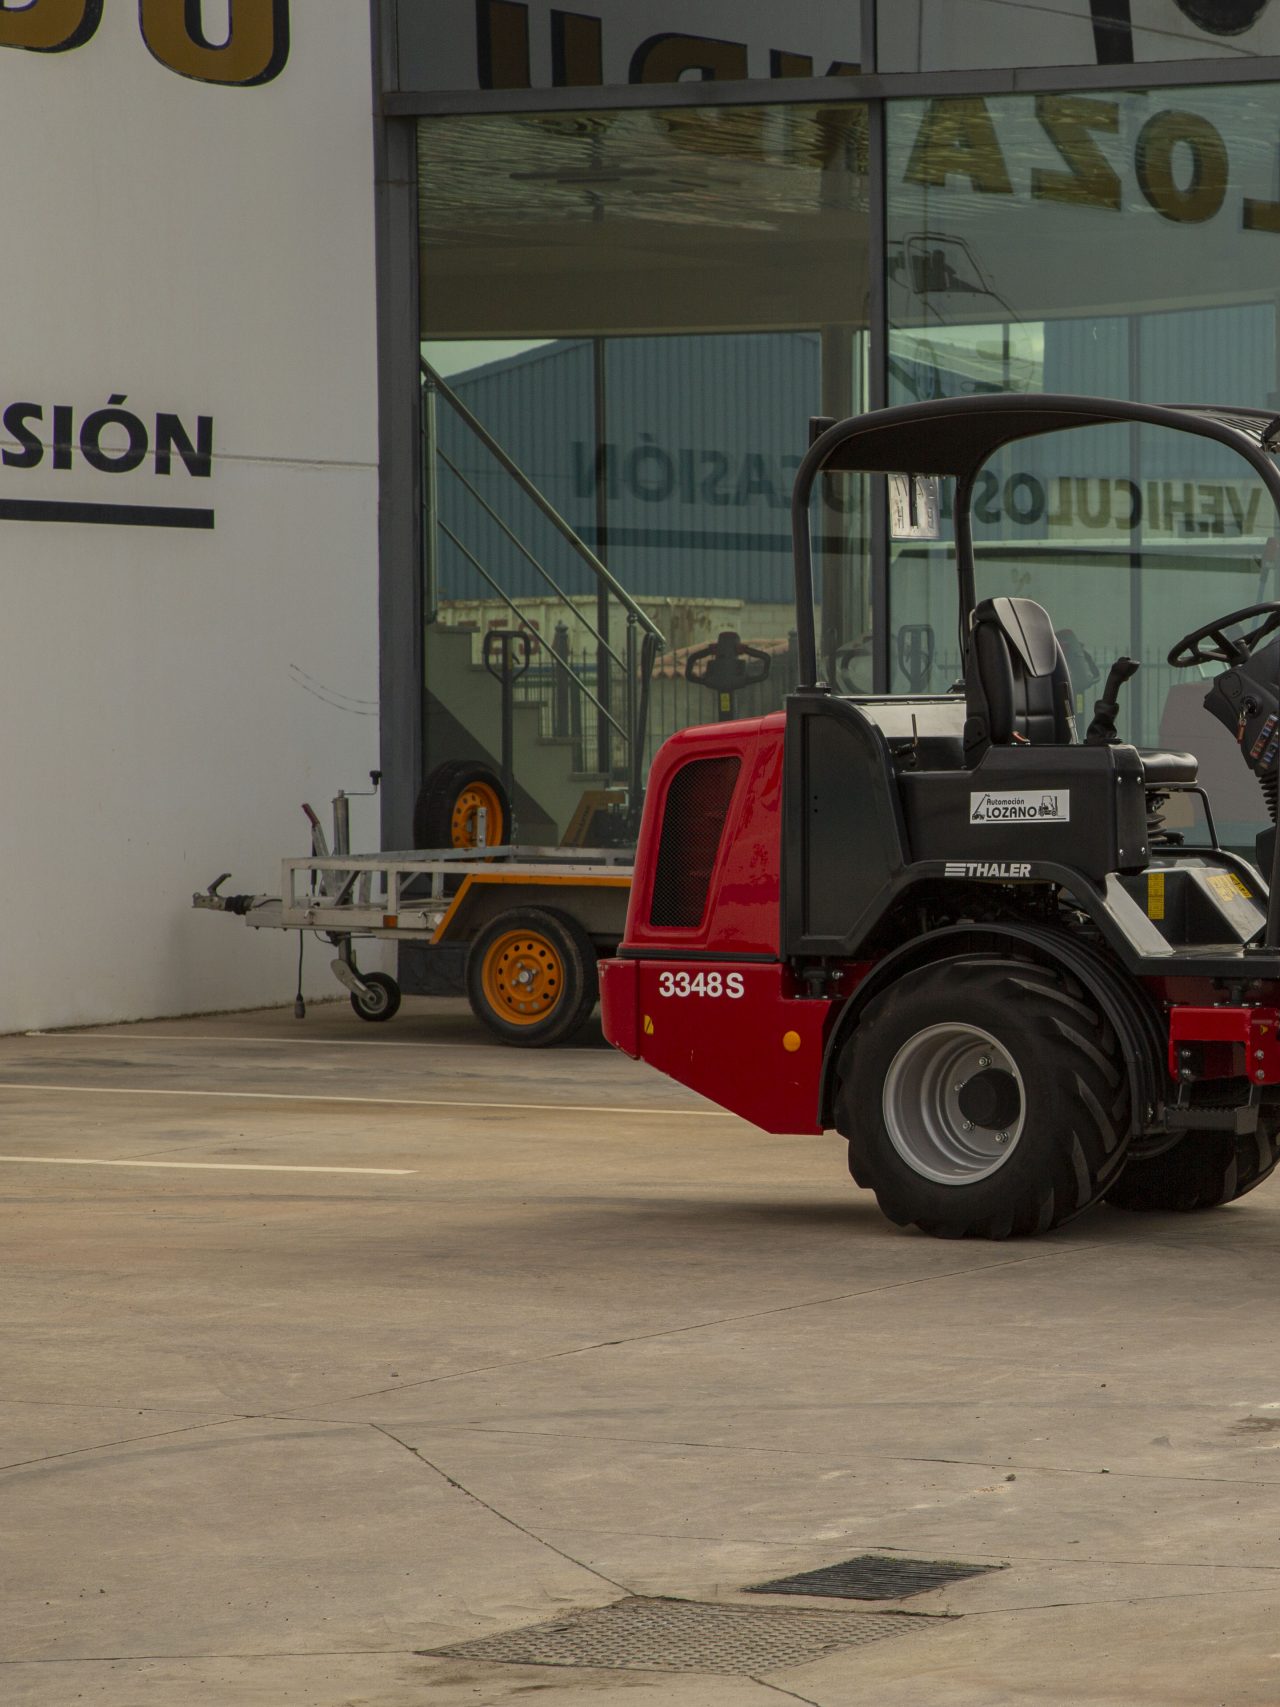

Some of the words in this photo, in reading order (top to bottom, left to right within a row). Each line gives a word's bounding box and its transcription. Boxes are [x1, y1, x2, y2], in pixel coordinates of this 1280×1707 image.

[986, 797, 1025, 806] Automoción
[986, 806, 1037, 818] LOZANO
[965, 863, 1032, 878] THALER
